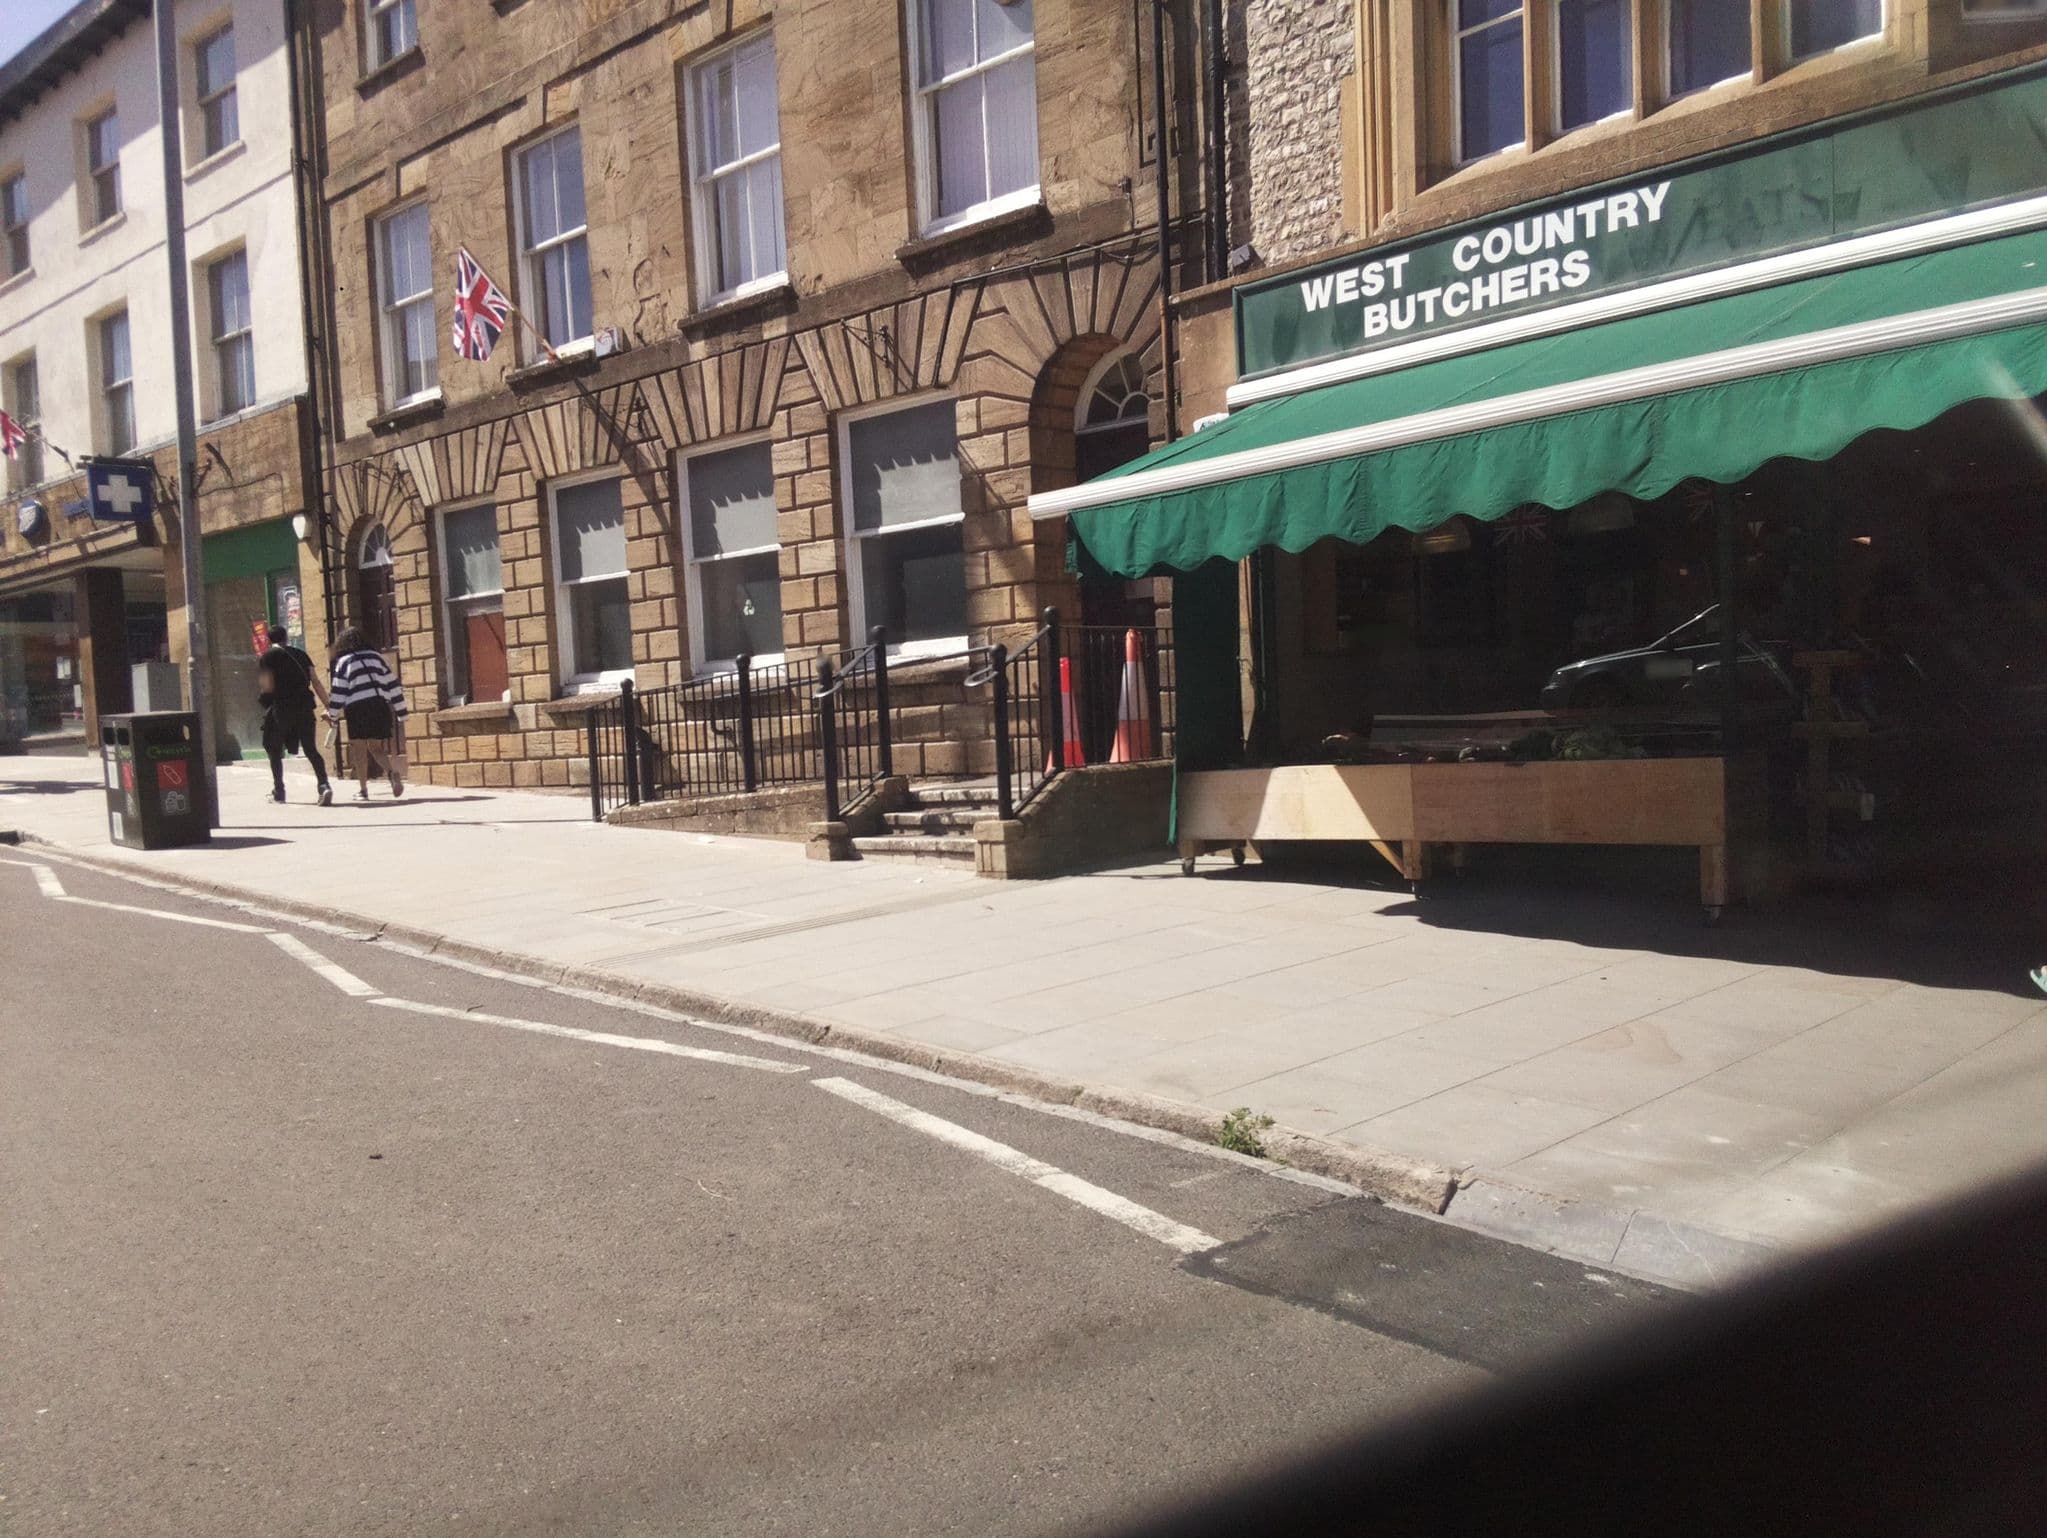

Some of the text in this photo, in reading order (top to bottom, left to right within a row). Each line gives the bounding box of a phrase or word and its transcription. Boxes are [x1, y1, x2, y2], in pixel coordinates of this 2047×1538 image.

[1301, 181, 1672, 313] WEST COUNTRY
[1363, 250, 1591, 339] BUTCHERS
